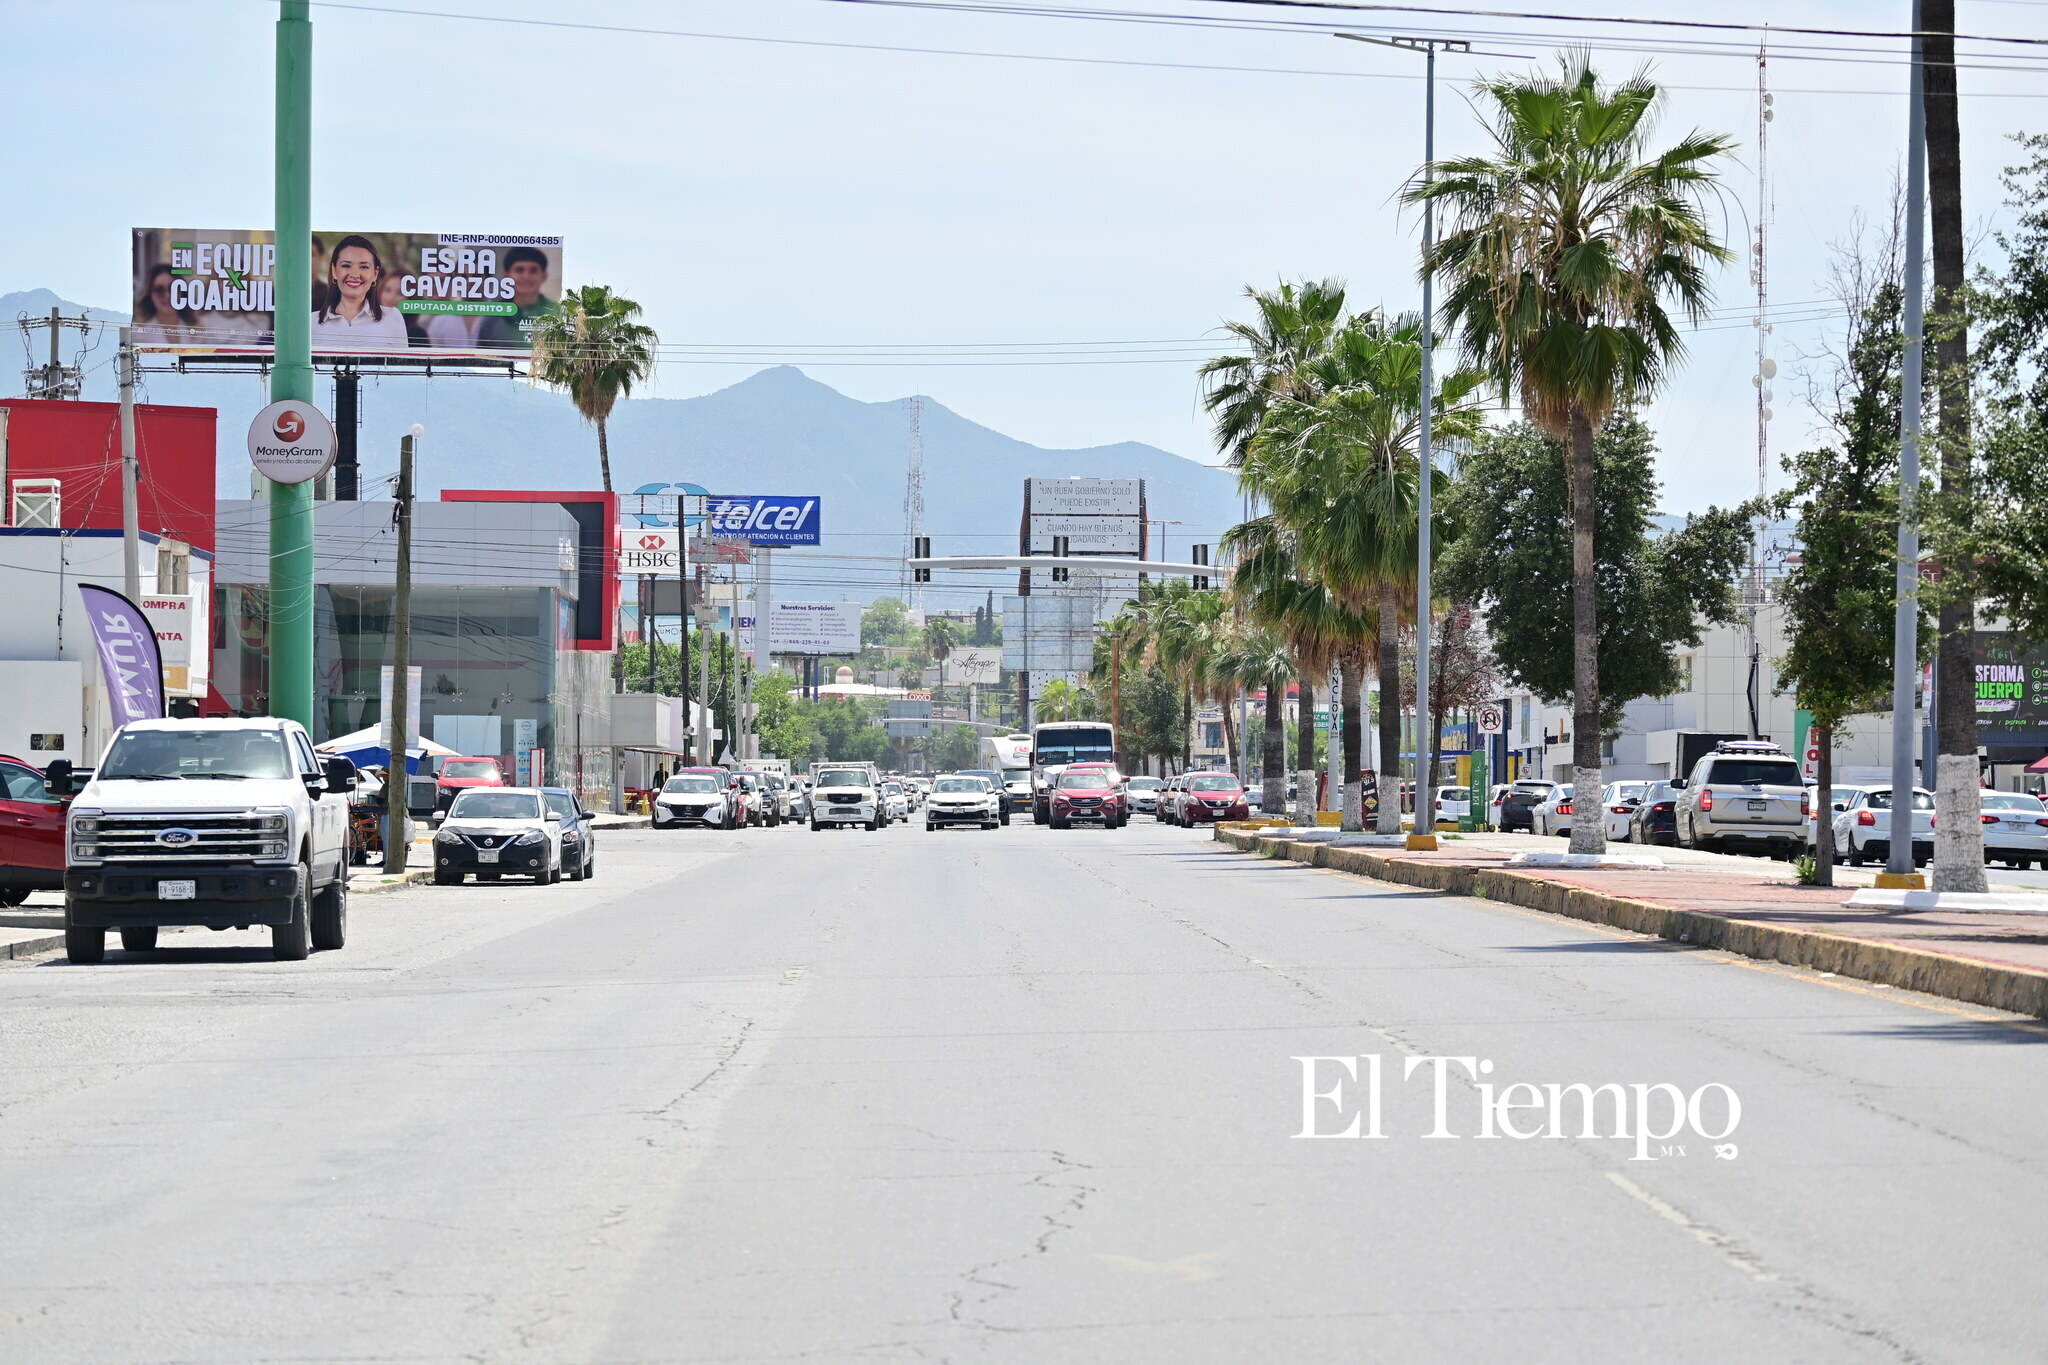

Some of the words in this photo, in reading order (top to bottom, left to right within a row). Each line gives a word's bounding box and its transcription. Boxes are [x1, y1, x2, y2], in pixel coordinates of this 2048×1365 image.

[172, 249, 192, 268] EN
[196, 243, 275, 278] EQUIP
[421, 248, 496, 275] ESRA
[400, 275, 515, 299] CAVAZOS
[170, 279, 275, 312] COAHUIL
[403, 302, 454, 311] DIPUTADA
[456, 304, 504, 312] DISTRITO
[506, 305, 513, 313] 5
[256, 446, 323, 458] MoneyGram
[1055, 487, 1073, 495] BUEN
[1075, 487, 1111, 495] GOBIERNO
[1112, 487, 1131, 495] SOLO
[711, 500, 815, 531] telcel
[1047, 524, 1077, 532] CUANDO
[1079, 524, 1093, 532] HAY
[1094, 524, 1123, 532] BUENOS
[628, 552, 676, 567] HSBC
[142, 600, 186, 610] OMPRA
[156, 632, 183, 641] NTA
[1975, 665, 2024, 682] SFORMA
[909, 693, 931, 701] OXXO
[1330, 660, 1339, 731] ONCLOVA
[166, 833, 186, 842] Ford
